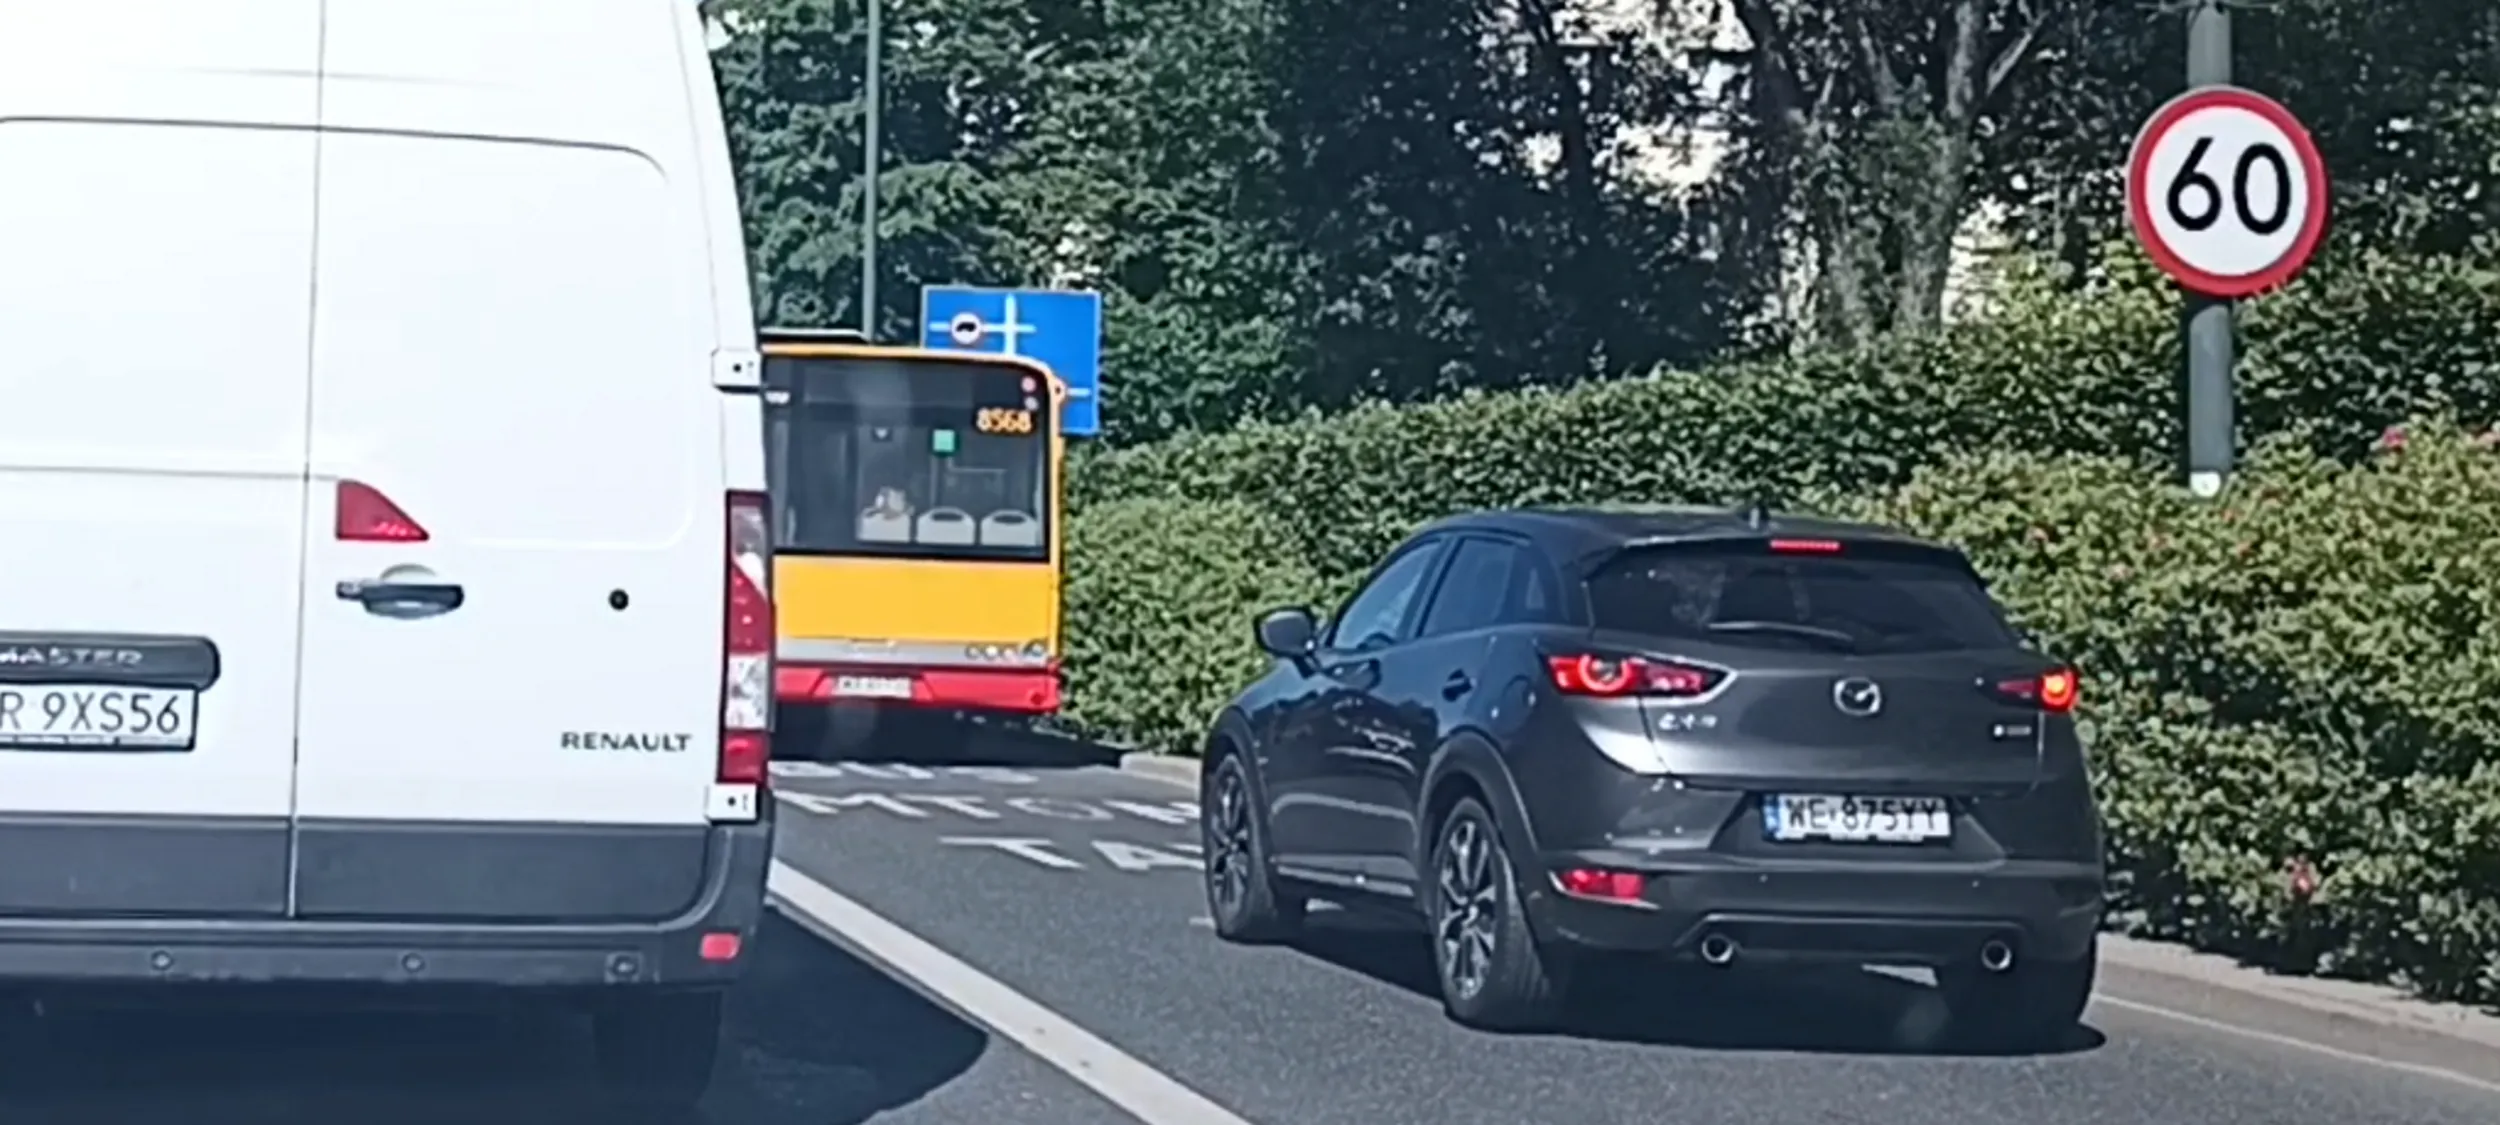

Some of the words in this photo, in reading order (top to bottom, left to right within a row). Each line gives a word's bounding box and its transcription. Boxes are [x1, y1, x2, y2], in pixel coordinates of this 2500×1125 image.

[2166, 136, 2291, 236] 60
[42, 691, 181, 734] 9XS56
[560, 731, 692, 752] RENAULT
[1785, 798, 1829, 829] WE
[1842, 798, 1947, 831] 875YY
